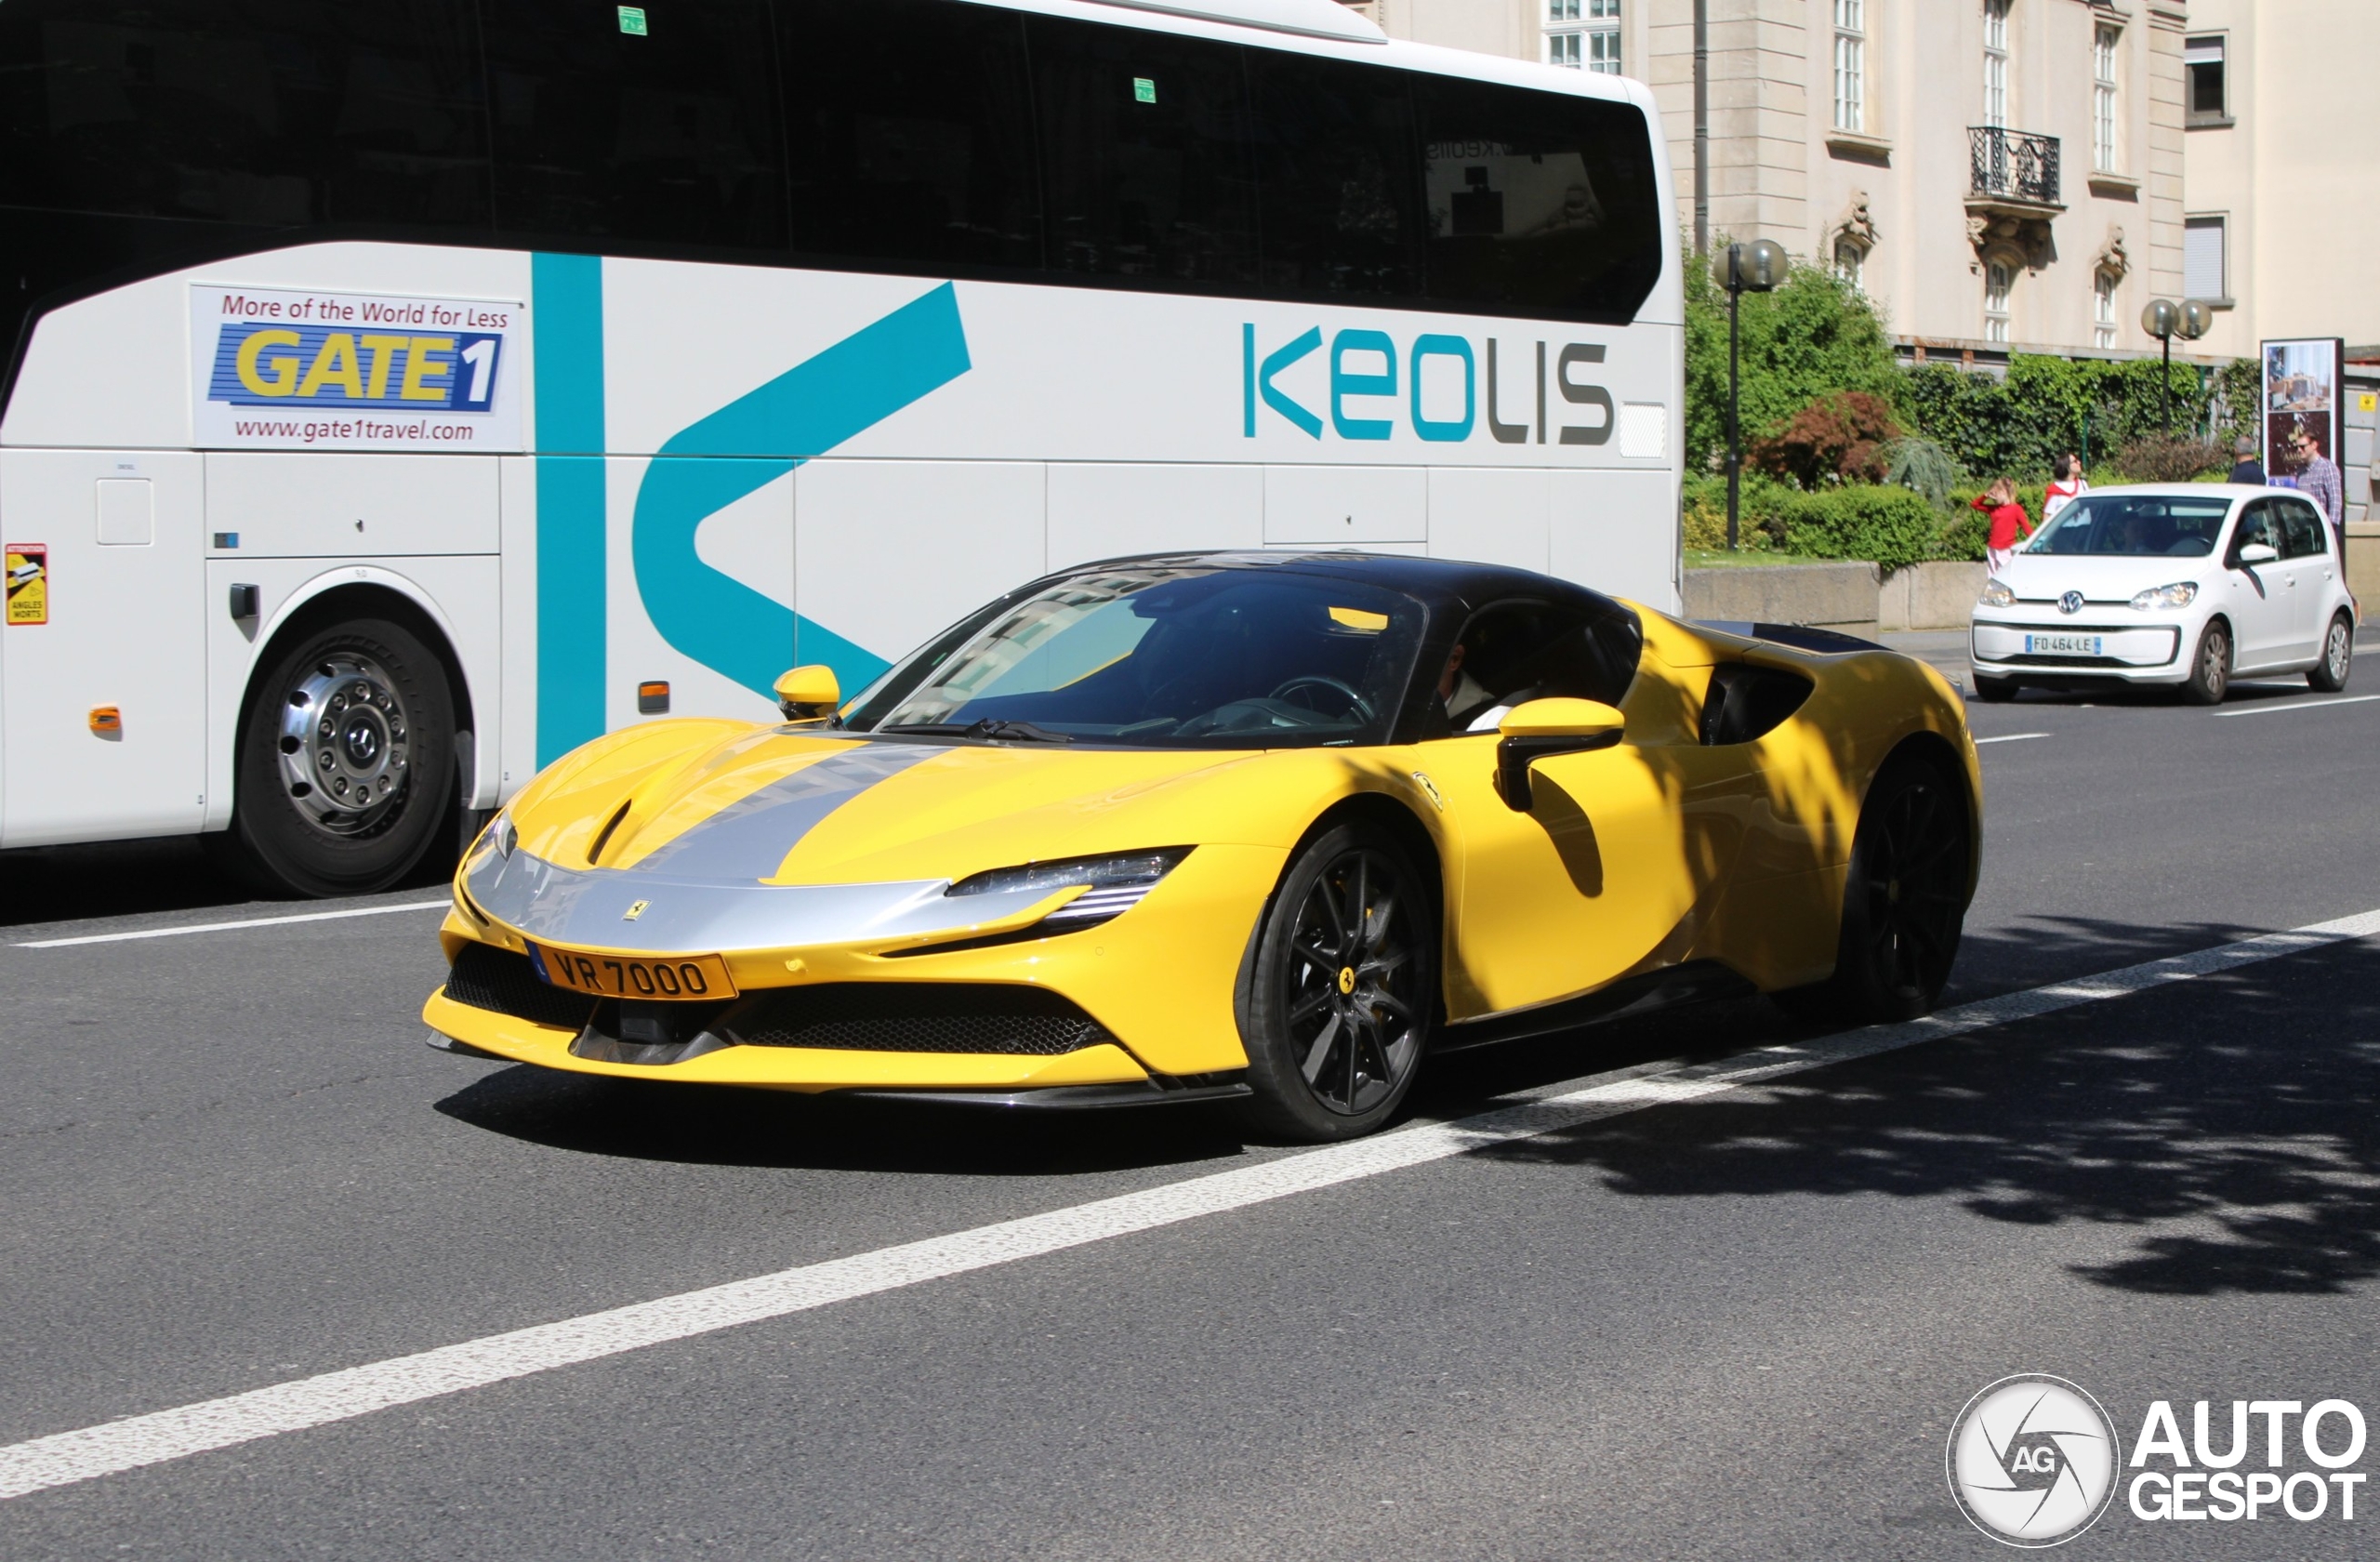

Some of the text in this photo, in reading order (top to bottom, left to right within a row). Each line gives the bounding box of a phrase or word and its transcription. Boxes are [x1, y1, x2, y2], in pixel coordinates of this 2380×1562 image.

[221, 295, 509, 328] More of the World for Less
[234, 419, 474, 443] www.gate1travel.com
[553, 952, 708, 996] VR 7000
